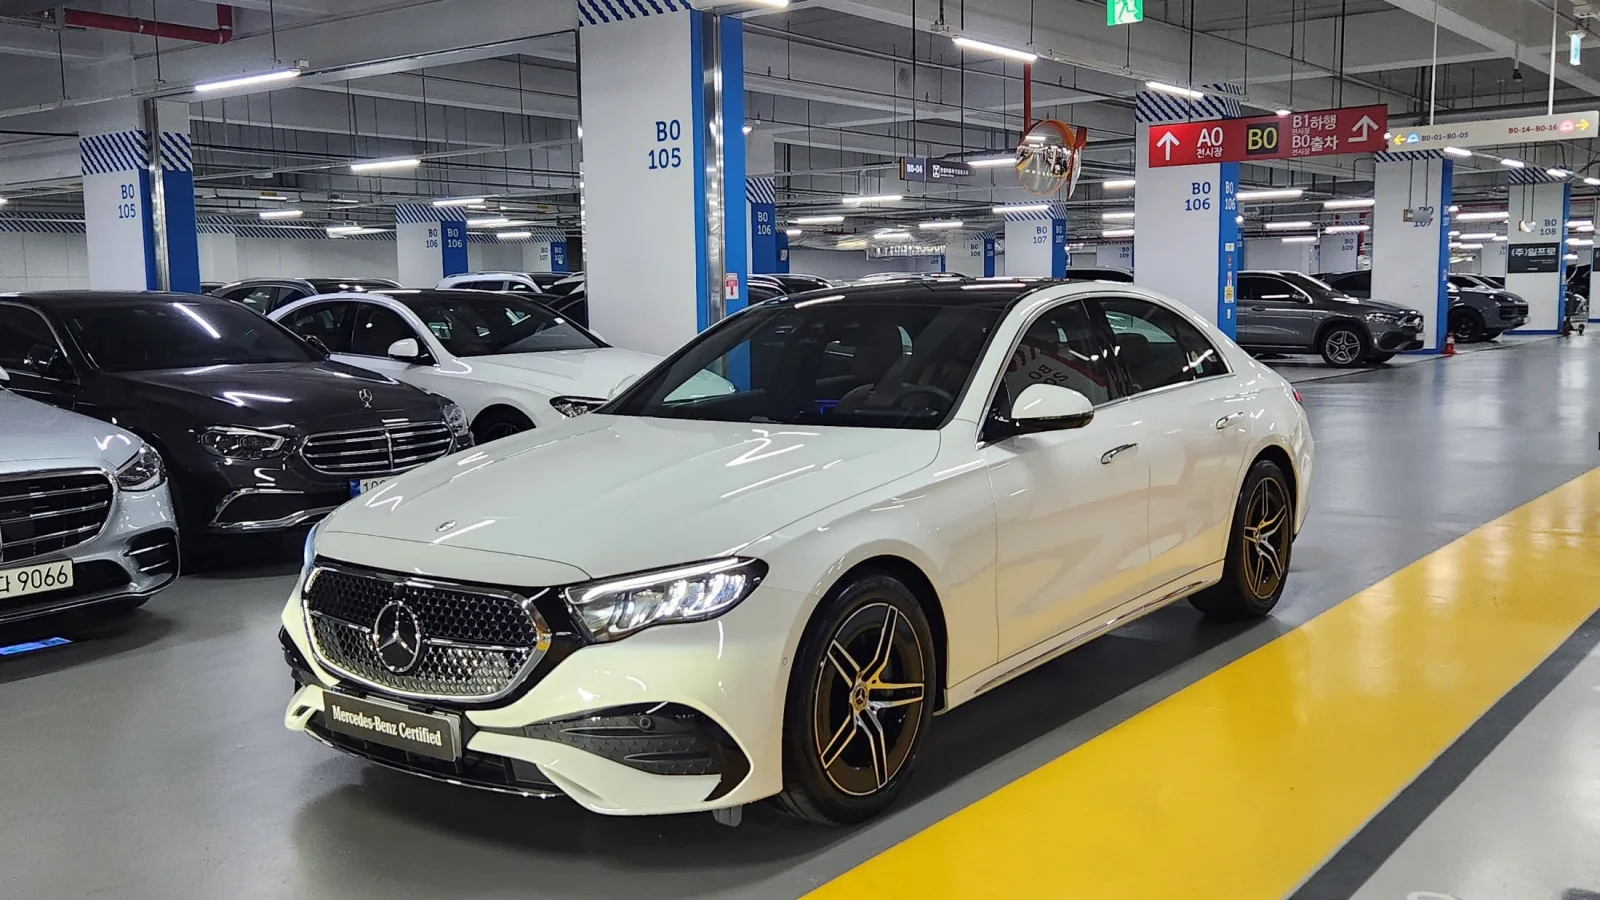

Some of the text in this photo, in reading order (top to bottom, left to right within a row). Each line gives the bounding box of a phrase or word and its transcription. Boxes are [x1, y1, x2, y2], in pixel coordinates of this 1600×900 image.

[656, 120, 680, 142] B0
[1196, 126, 1224, 148] A0
[1248, 127, 1278, 150] B0
[1196, 146, 1224, 158] 전시장
[648, 148, 682, 170] 105
[121, 184, 134, 199] B0
[1192, 182, 1211, 195] B0
[118, 204, 136, 218] 105
[1185, 198, 1211, 211] 106
[1225, 198, 1235, 211] 106
[758, 212, 768, 222] B0
[758, 225, 772, 235] 106
[426, 240, 438, 248] 106
[448, 239, 462, 248] 106
[17, 565, 68, 591] 9066
[332, 704, 442, 746] Mercedes-Benz Certified
